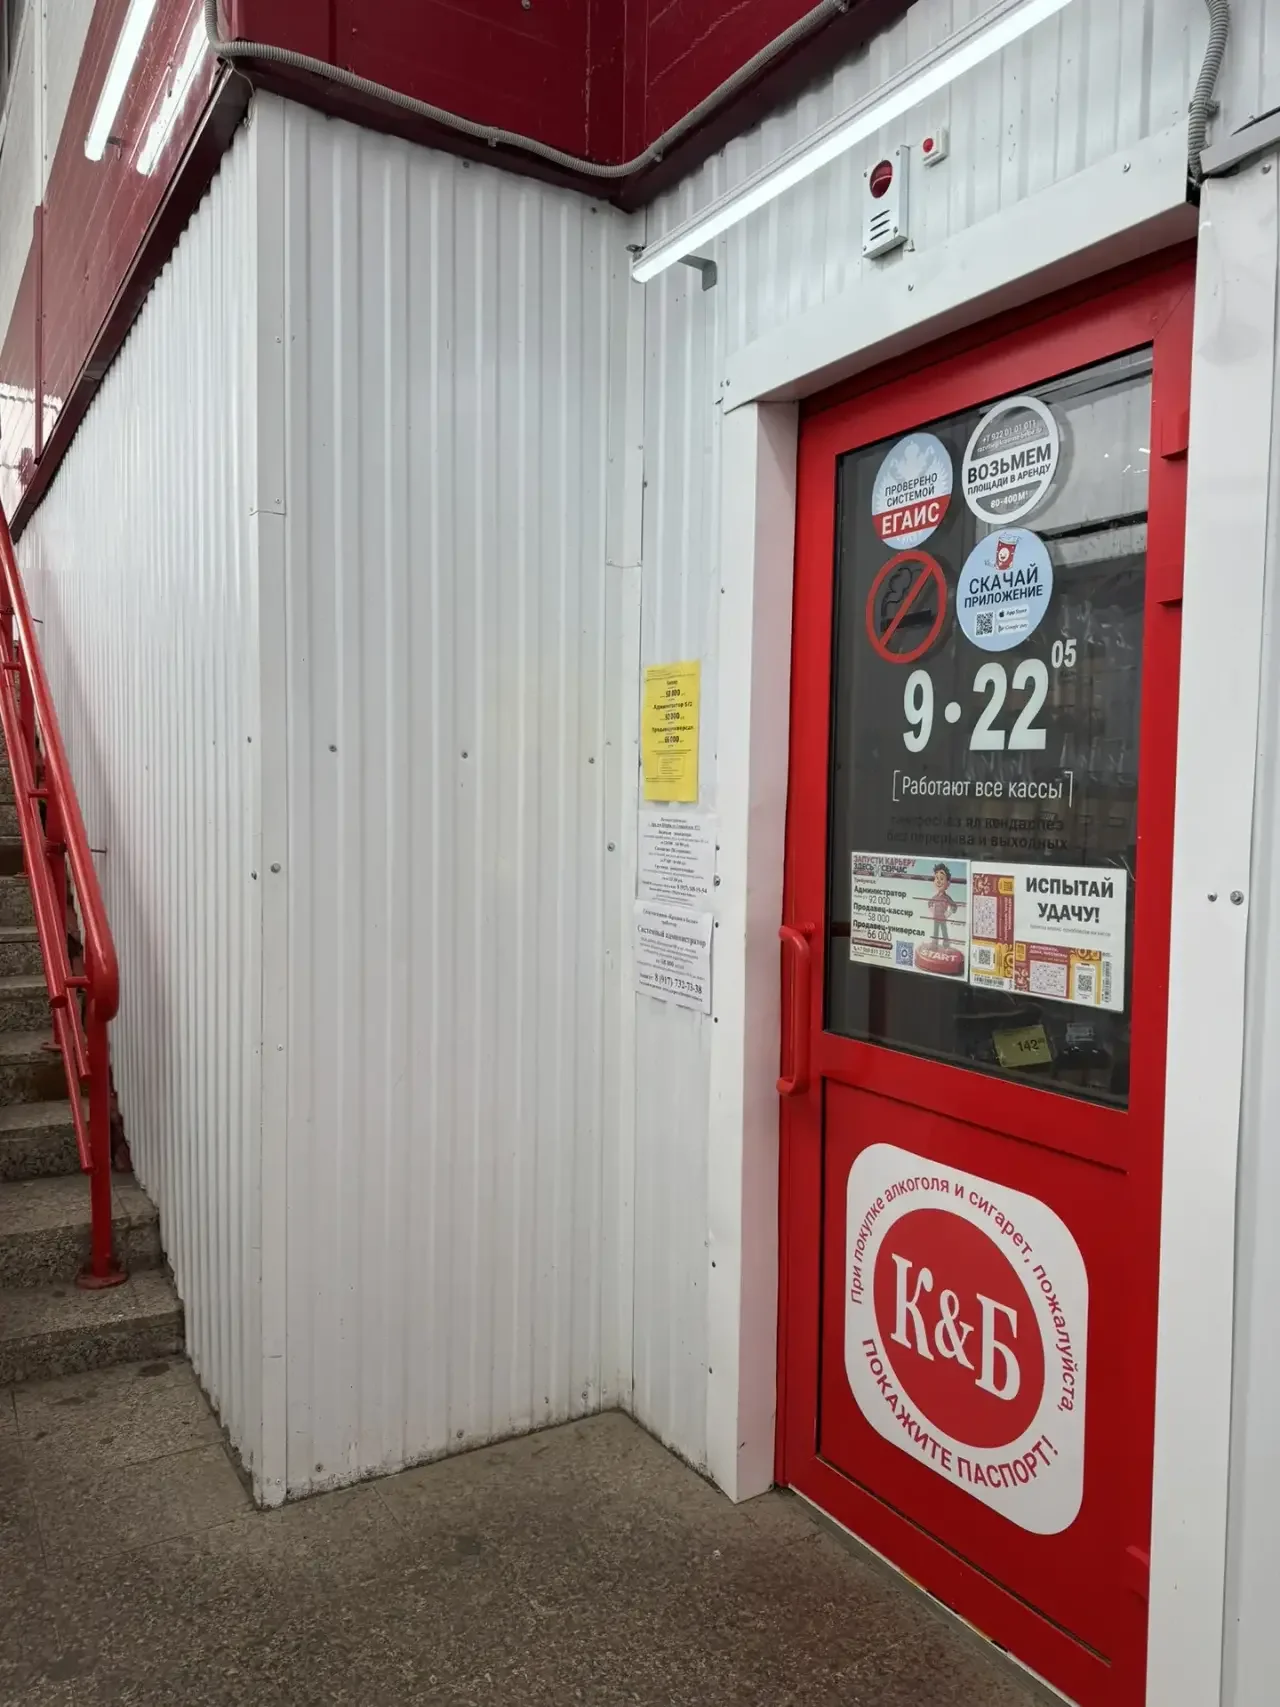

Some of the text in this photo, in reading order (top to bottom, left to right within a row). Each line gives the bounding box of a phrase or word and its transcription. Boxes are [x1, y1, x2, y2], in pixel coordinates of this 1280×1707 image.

[967, 443, 1051, 484] ВОЗЬМЕМ
[885, 472, 938, 496] ПРОВЕРЕНО
[967, 463, 1052, 495] ПЛОЩАДИ В АРЕНДУ
[886, 484, 935, 508] СИСТЕМОЙ
[881, 502, 940, 535] ЕГАИС
[969, 563, 1038, 595] СКАЧАЙ
[964, 584, 1043, 608] ПРИЛОЖЕНИЕ
[903, 638, 1077, 753] 9 22 05
[975, 781, 1003, 797] все
[990, 834, 1068, 851] выходных
[853, 855, 916, 867] ЗАПУСТИ КАРЬЕРУ
[853, 863, 874, 871] ЗДЕСЬ
[854, 886, 906, 899] Администратор
[1026, 876, 1113, 898] ИСПЫТАЙ
[853, 903, 913, 917] Продавец-кассир
[868, 895, 890, 905] 92 000
[878, 914, 890, 923] 000
[1037, 903, 1100, 923] УДАЧУ!
[853, 920, 925, 936] Продавец-универсал
[867, 931, 892, 941] 66 000
[920, 949, 957, 961] START
[850, 1176, 1082, 1412] При покупке алкоголя и сигарет, пожалуйста,
[890, 1252, 1021, 1401] К&Б
[862, 1338, 1059, 1488] ПОКАЖИТЕ ПАСПОРТ!
